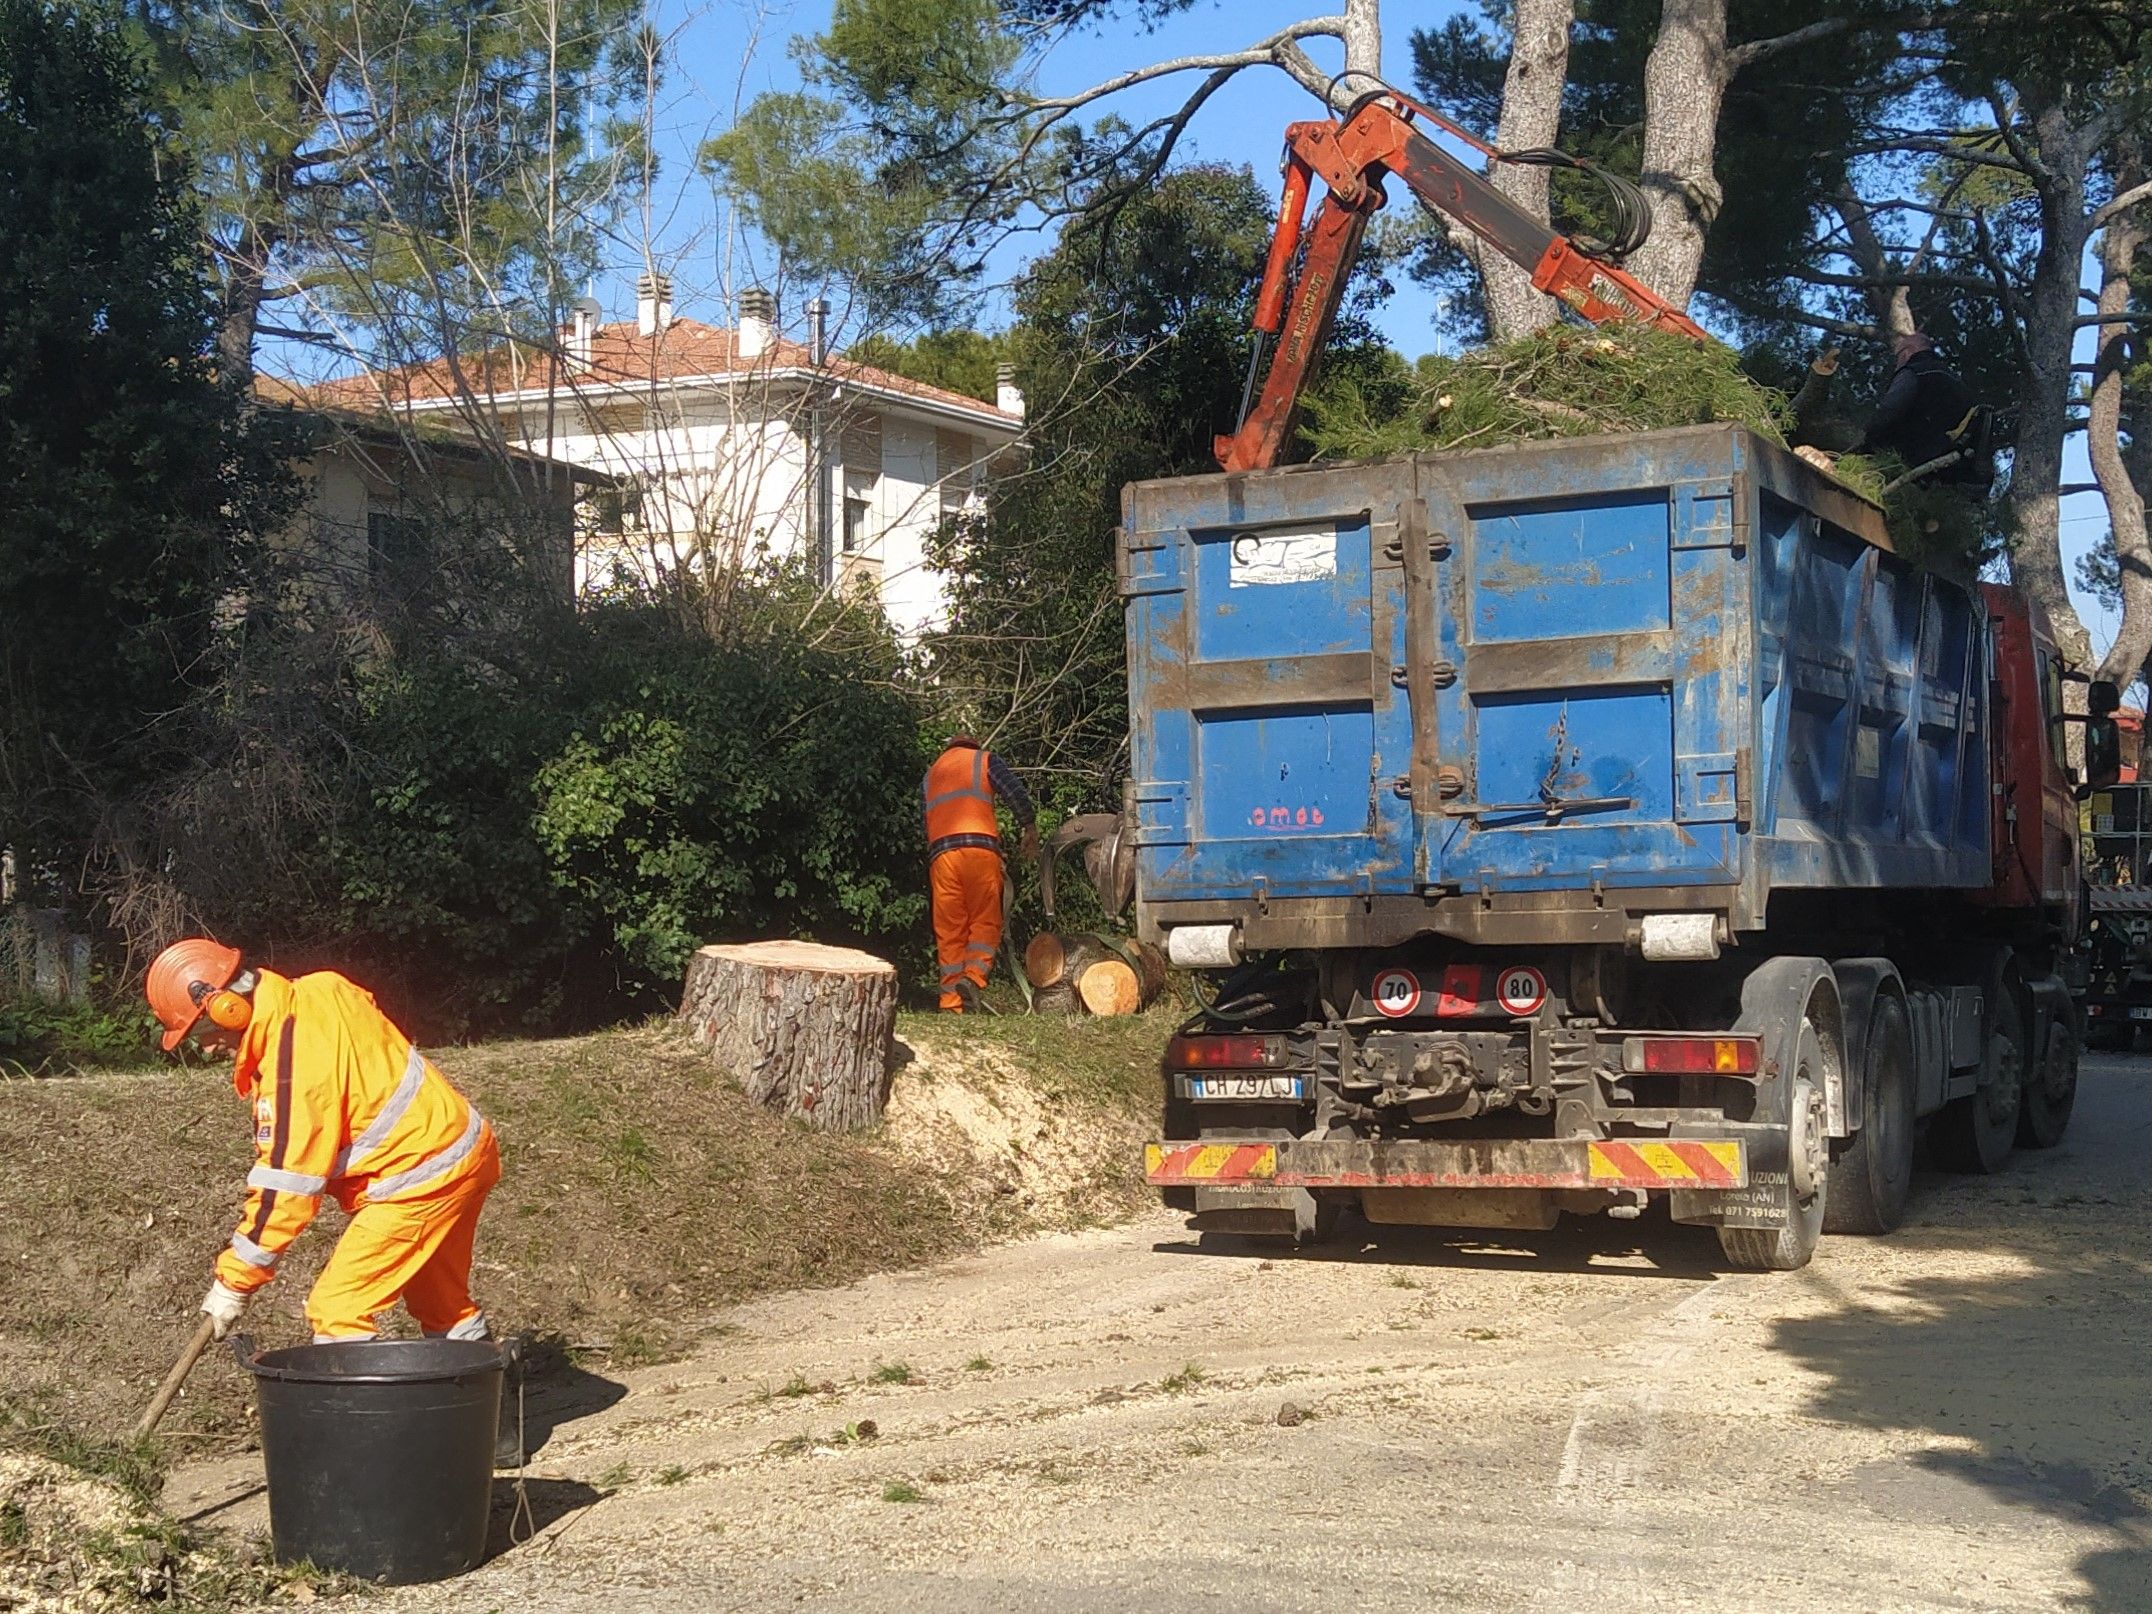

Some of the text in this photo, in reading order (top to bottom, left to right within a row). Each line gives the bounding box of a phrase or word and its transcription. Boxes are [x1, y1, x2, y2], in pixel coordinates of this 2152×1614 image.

[1386, 981, 1408, 1001] 70
[1509, 978, 1533, 998] 80
[1725, 1206, 1743, 1216] 071
